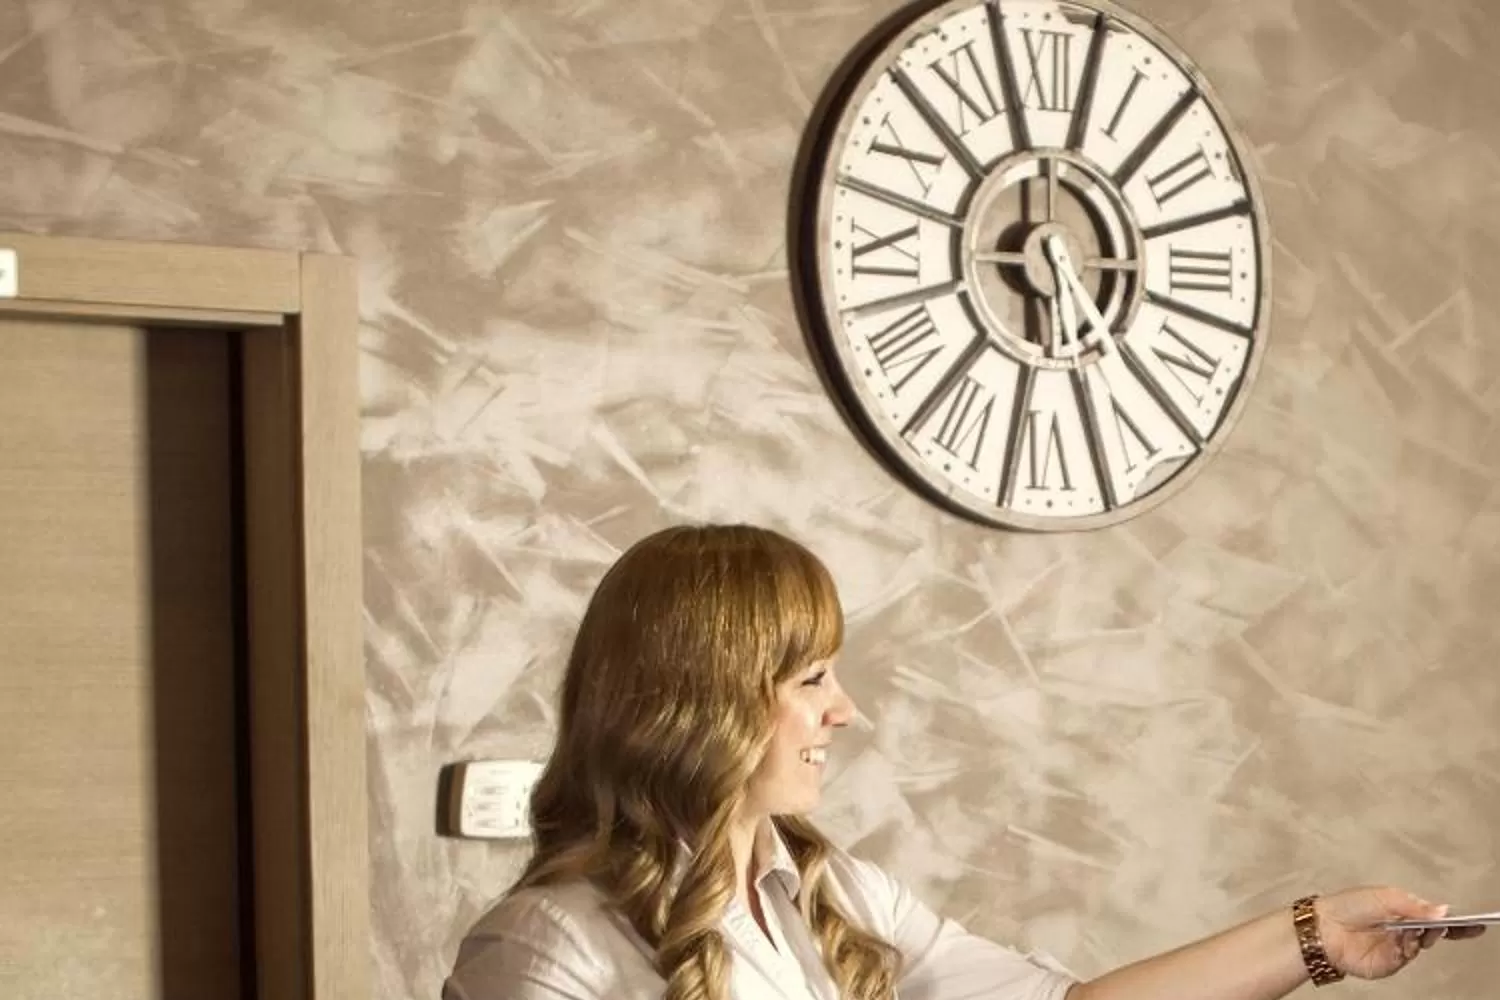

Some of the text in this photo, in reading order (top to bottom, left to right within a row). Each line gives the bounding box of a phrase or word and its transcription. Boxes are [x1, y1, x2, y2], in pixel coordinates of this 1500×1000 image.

[928, 39, 1006, 137] XI
[1017, 27, 1075, 112] XII
[1099, 65, 1149, 142] I
[867, 112, 946, 199] X
[1144, 142, 1216, 212] II
[852, 216, 920, 284] IX
[1168, 243, 1232, 299] III
[865, 301, 947, 397] VIII
[932, 375, 997, 473] VII
[1024, 410, 1076, 491] VI
[1108, 391, 1163, 475] V
